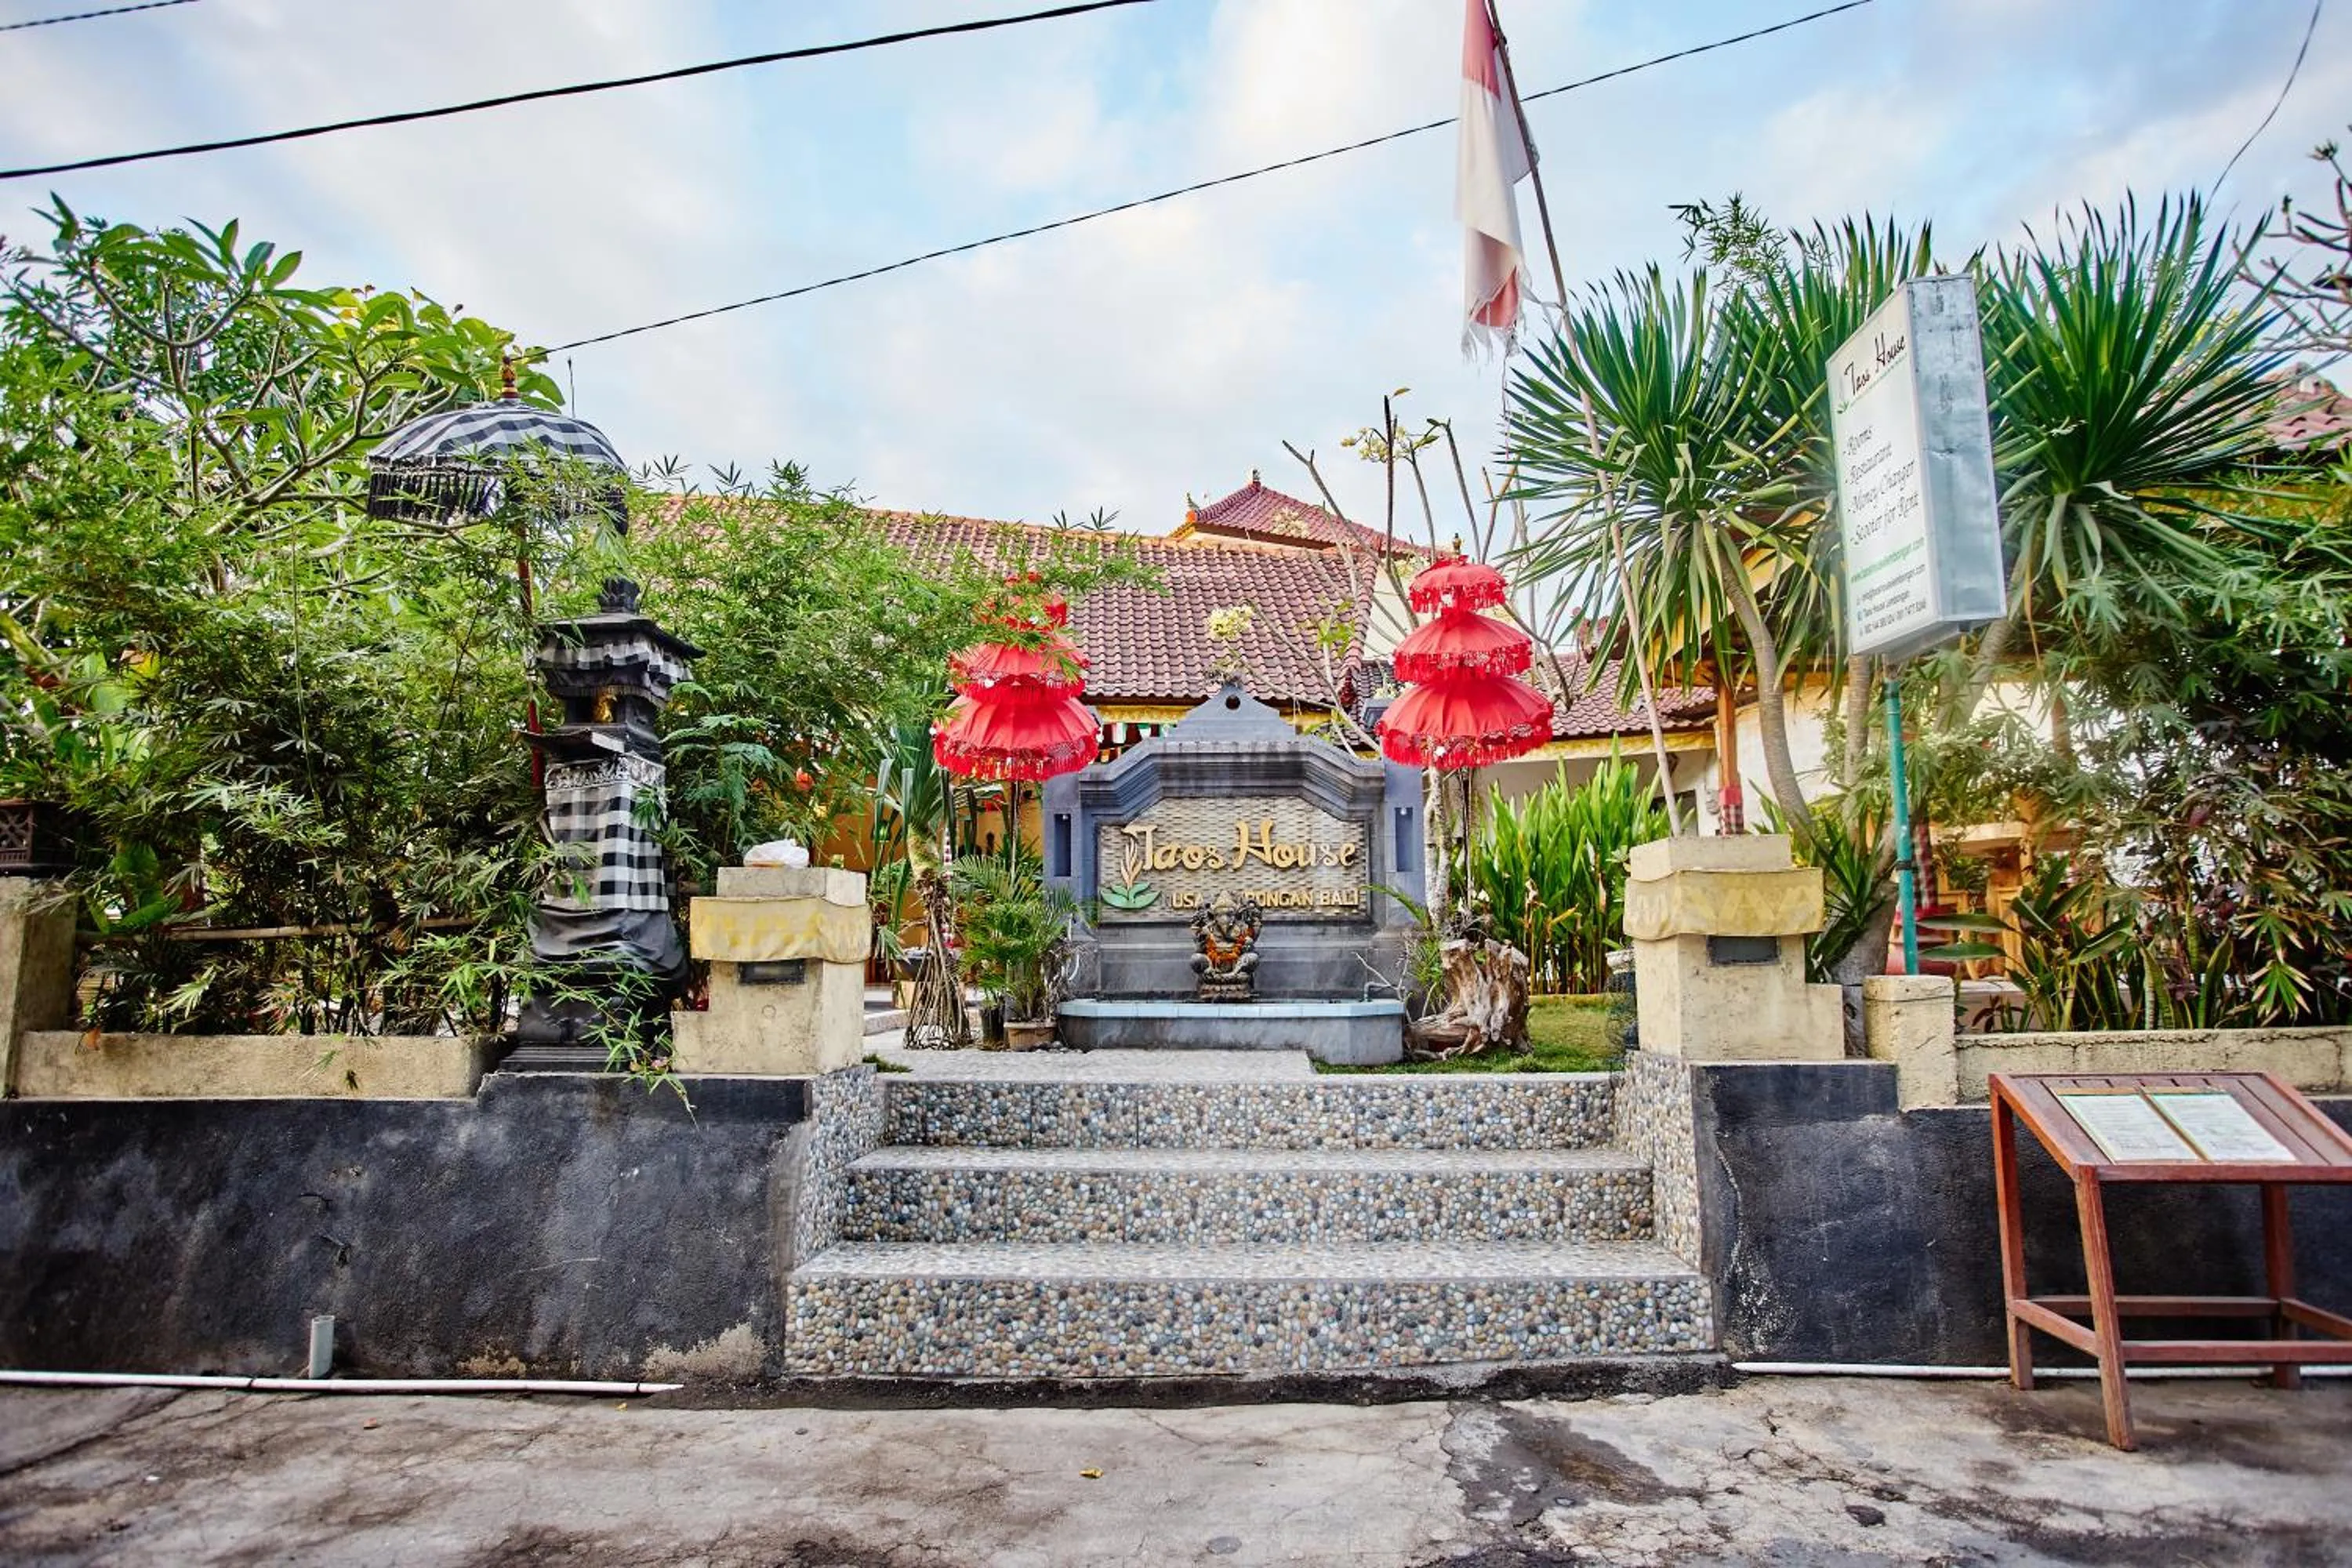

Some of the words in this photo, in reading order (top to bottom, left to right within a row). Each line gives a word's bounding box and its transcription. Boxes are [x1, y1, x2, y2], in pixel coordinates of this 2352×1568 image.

[1875, 332, 1906, 372] House
[1121, 823, 1227, 870] Taos
[1232, 820, 1356, 870] House
[1319, 888, 1359, 906] BALI
